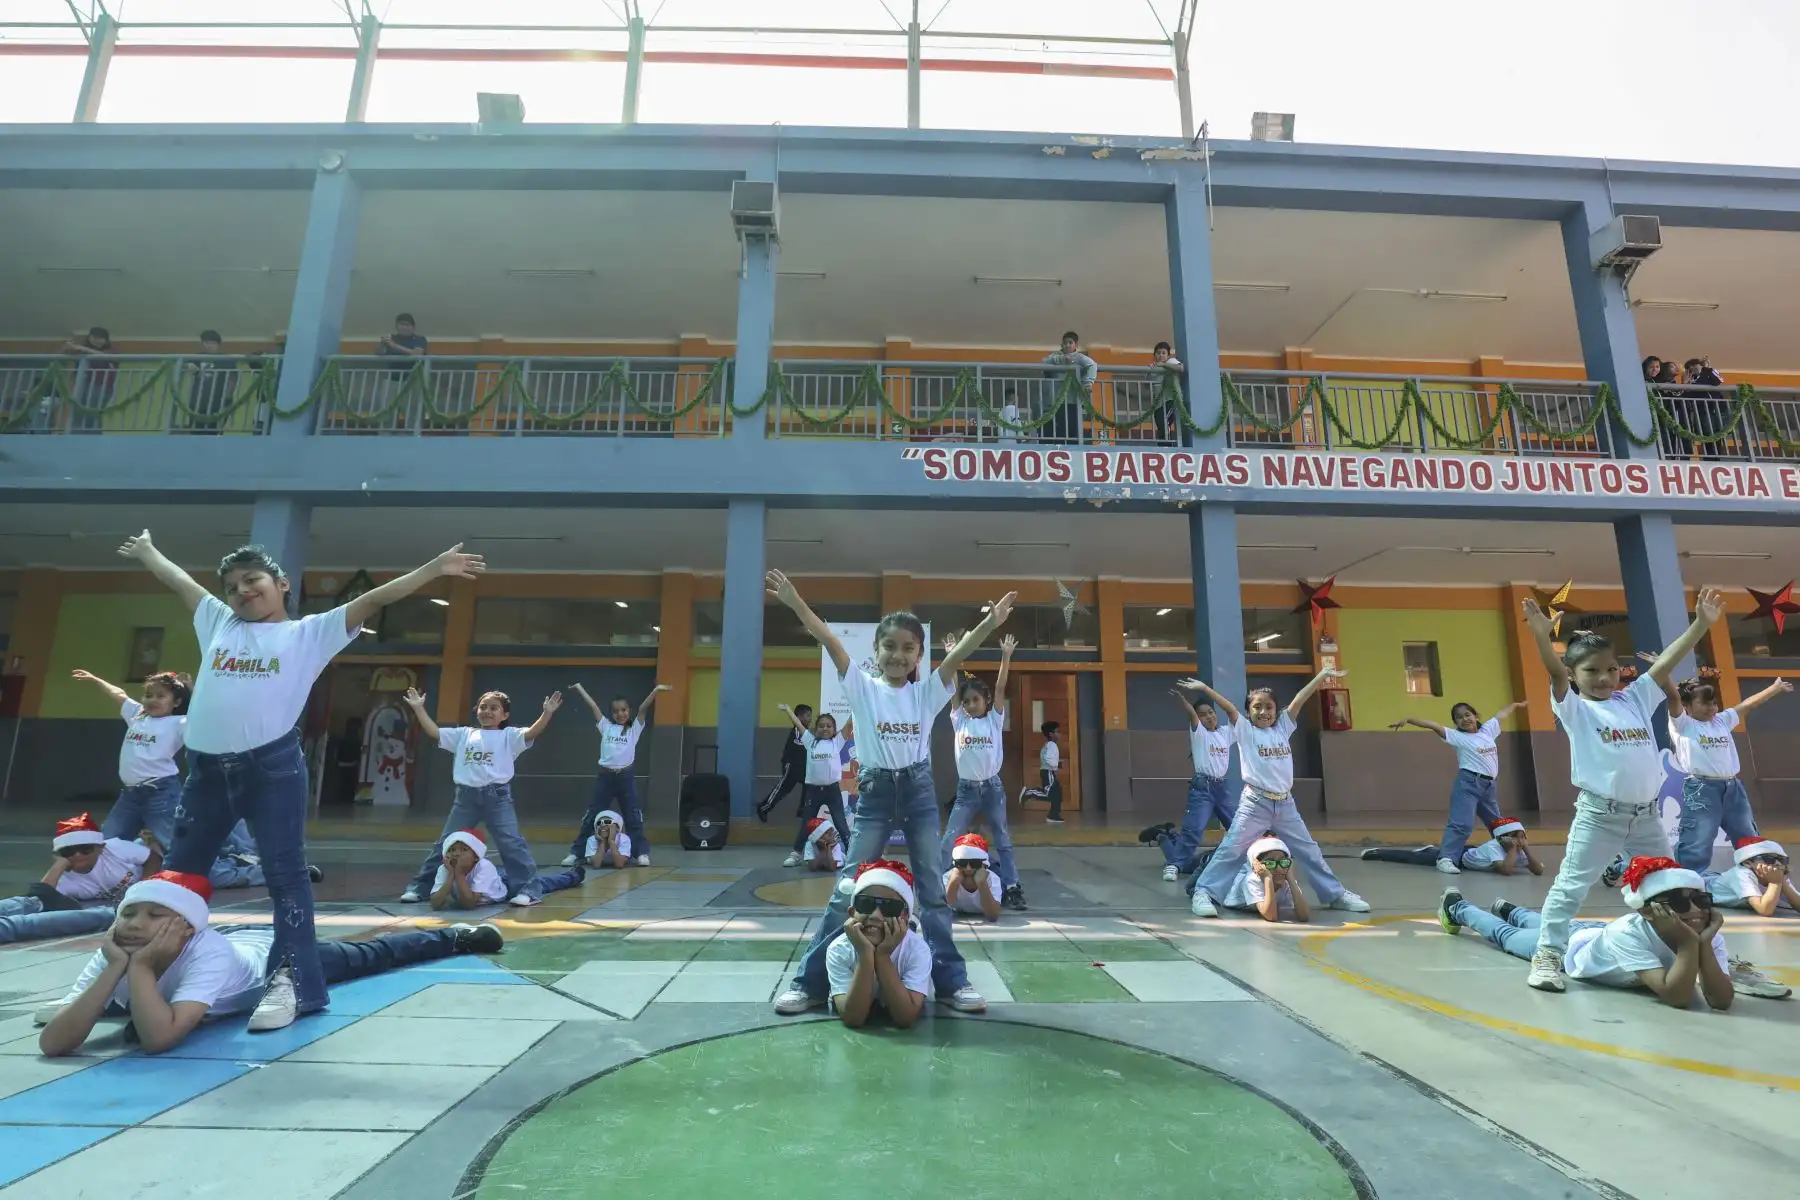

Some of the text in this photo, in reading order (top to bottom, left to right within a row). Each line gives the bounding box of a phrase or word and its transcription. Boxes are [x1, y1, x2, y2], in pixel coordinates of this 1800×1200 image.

[901, 448, 1800, 499] "SOMOS BARCAS NAVEGANDO JUNTOS HACIA E
[211, 655, 280, 674] KAMILA
[465, 750, 494, 762] ZOE
